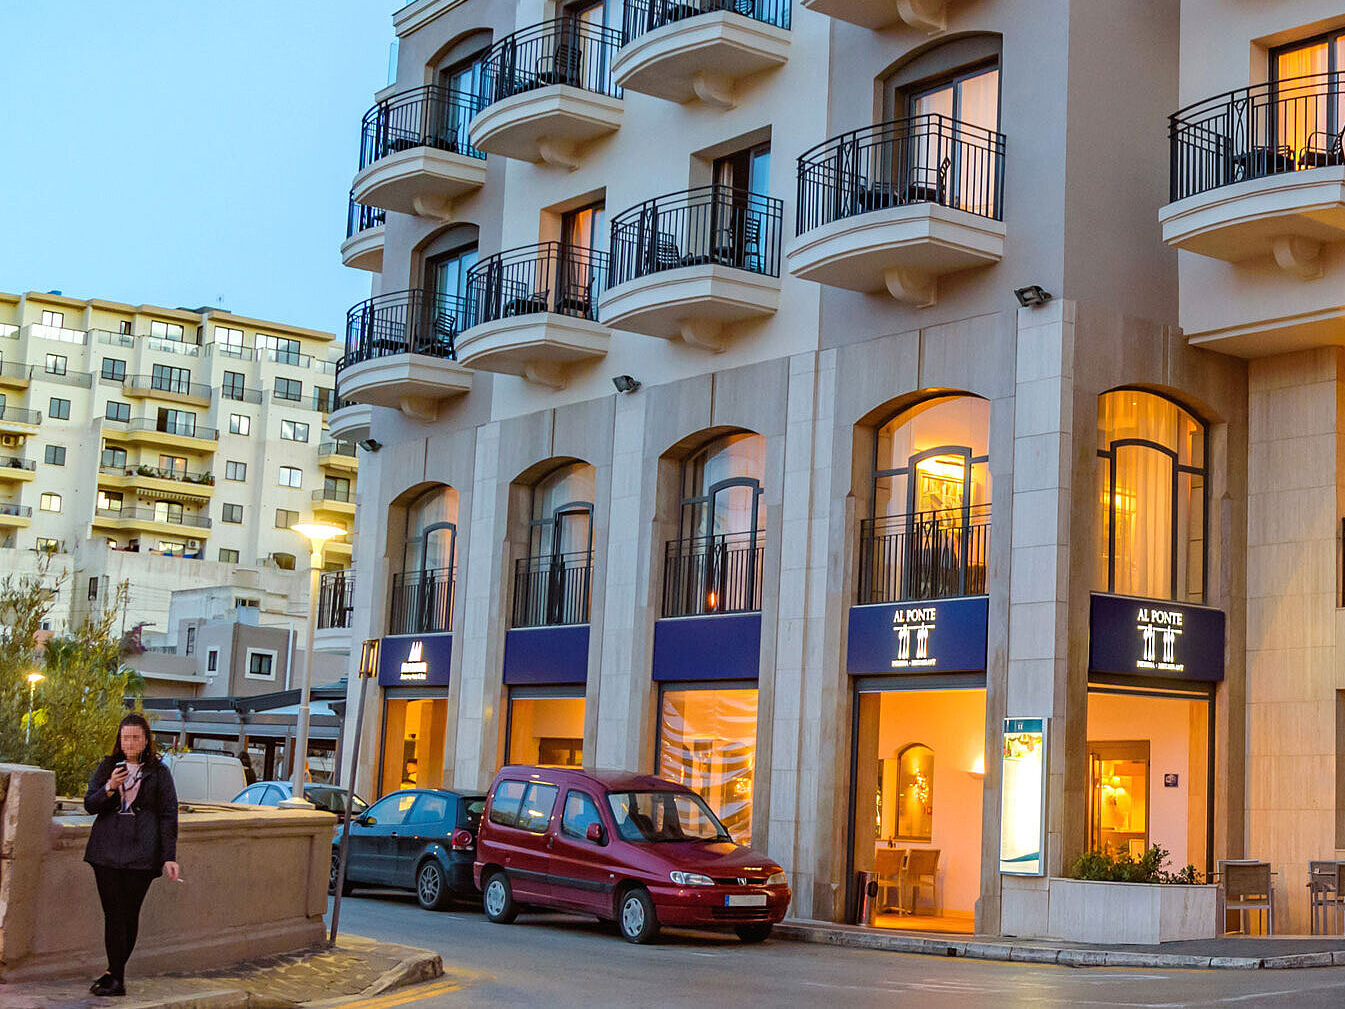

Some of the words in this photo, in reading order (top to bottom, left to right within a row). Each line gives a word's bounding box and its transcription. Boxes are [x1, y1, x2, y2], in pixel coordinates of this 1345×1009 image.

[893, 609, 905, 623] AL
[905, 607, 936, 622] PONTE
[1137, 607, 1150, 622] AL
[1150, 609, 1183, 626] PONTE
